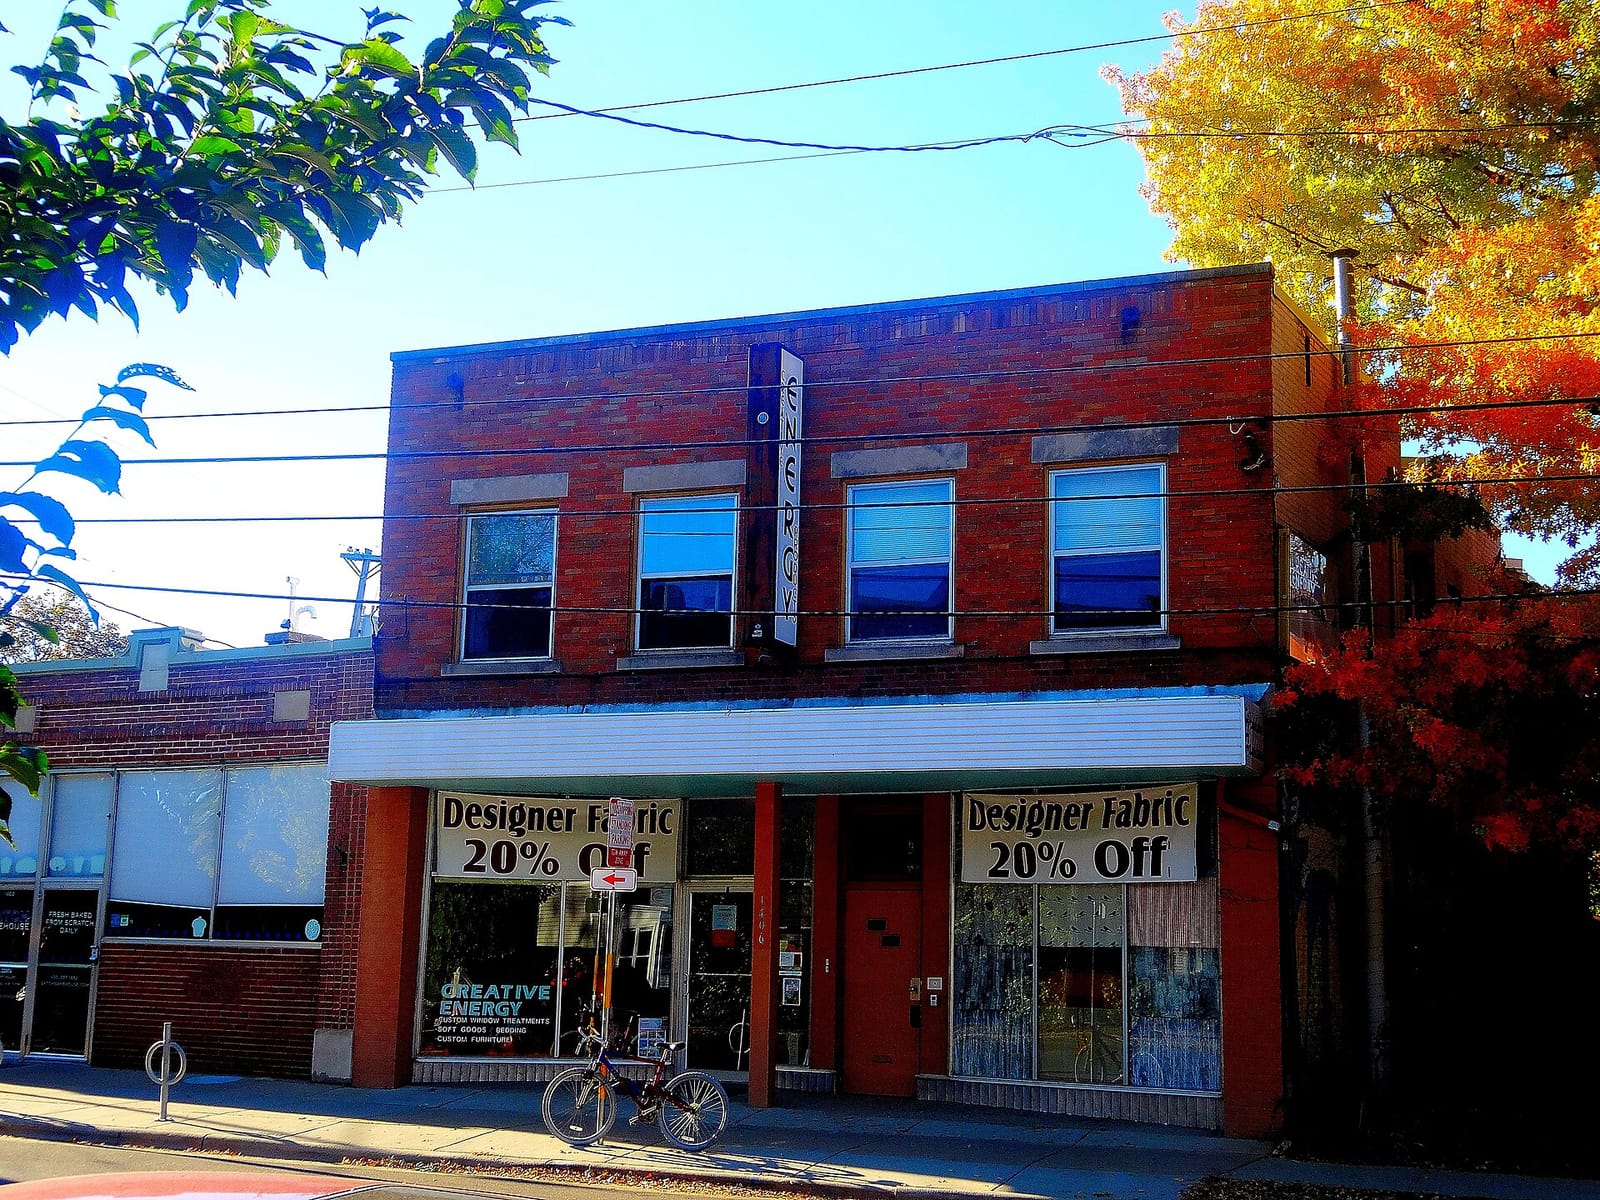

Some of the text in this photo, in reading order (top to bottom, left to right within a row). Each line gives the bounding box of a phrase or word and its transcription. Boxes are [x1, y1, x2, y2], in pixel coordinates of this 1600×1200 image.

[782, 376, 798, 621] ENERGY
[443, 797, 673, 838] Designer Faric
[968, 790, 1191, 838] Designer Fabric
[610, 833, 632, 845] PARKING
[463, 839, 651, 878] 20% Of
[987, 835, 1169, 879] 20% Off
[48, 911, 69, 919] FRESH
[441, 983, 551, 1000] CREATIVE
[439, 1016, 467, 1024] CUSTOM
[503, 1017, 550, 1025] TREATMENTS
[440, 1000, 522, 1017] ENERGY
